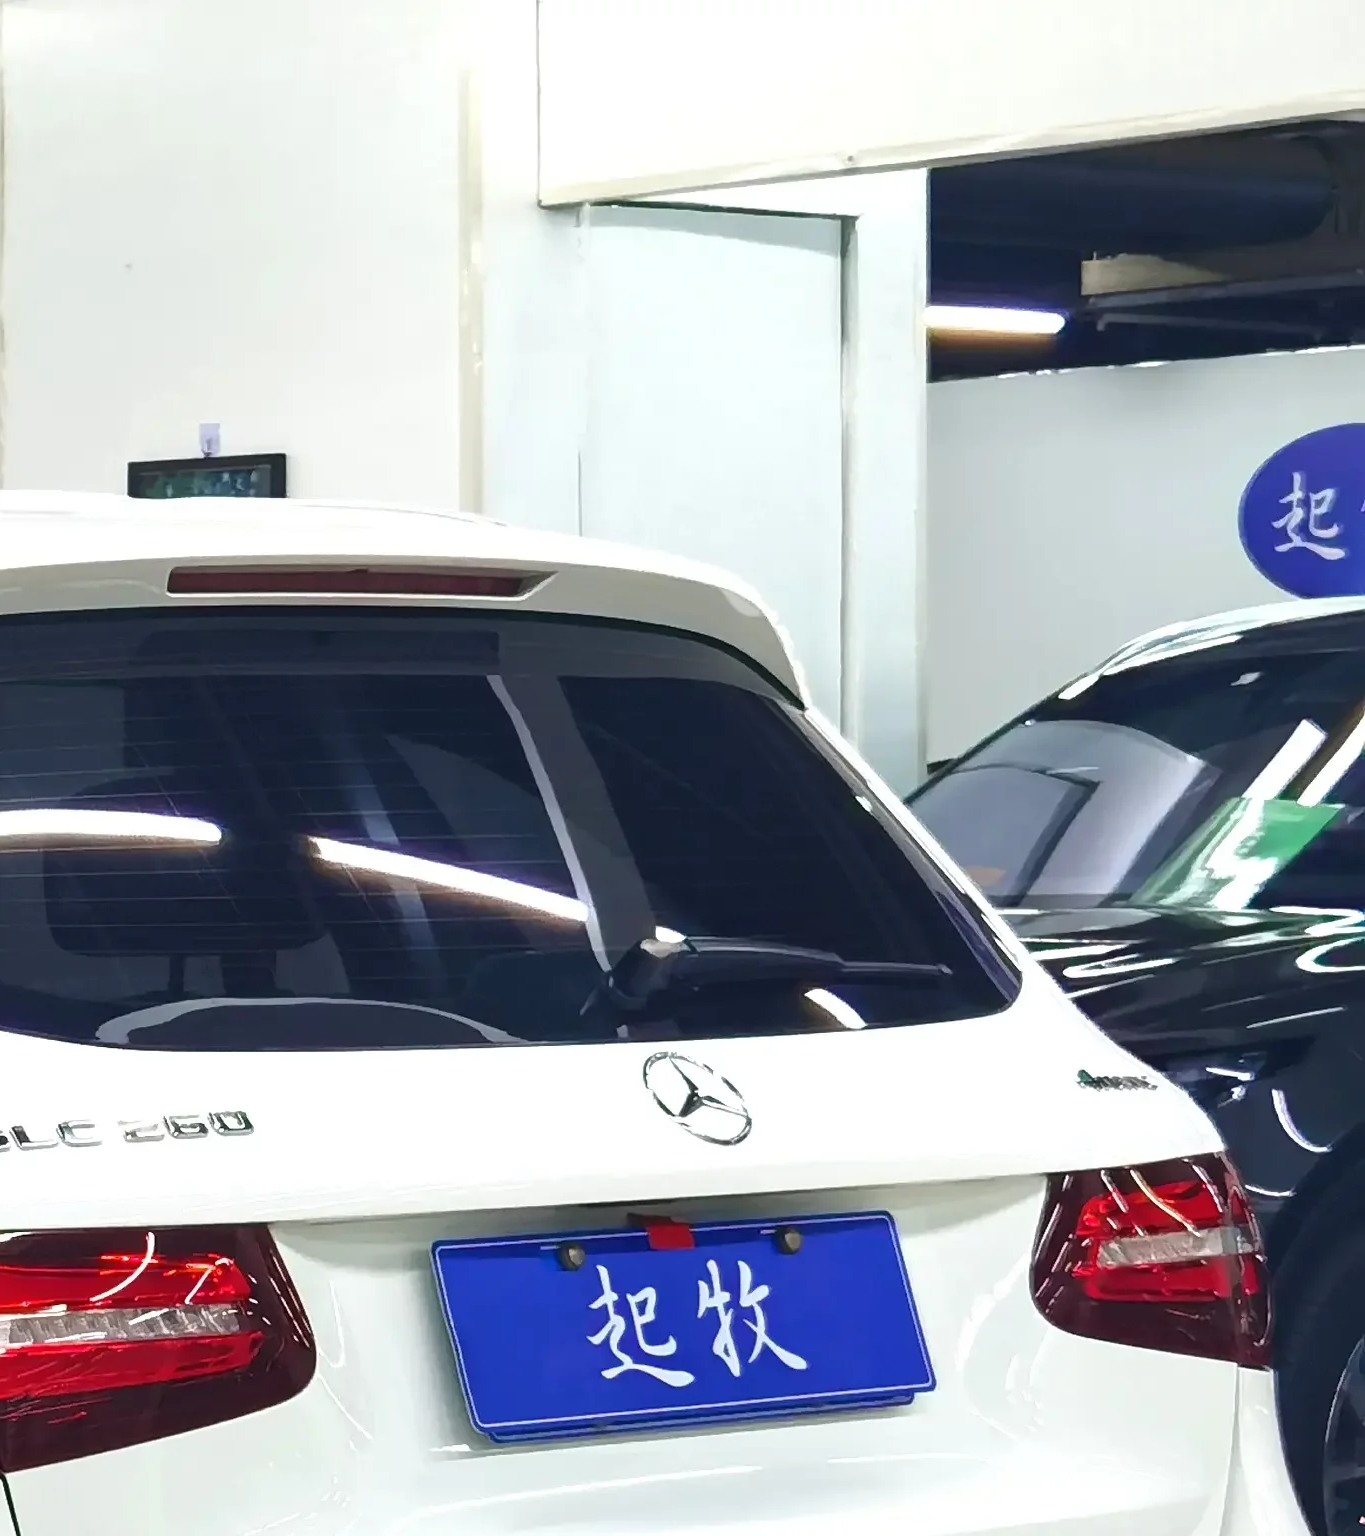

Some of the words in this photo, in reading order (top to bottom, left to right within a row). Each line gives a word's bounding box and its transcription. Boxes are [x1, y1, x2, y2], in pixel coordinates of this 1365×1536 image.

[1271, 471, 1365, 561] 起
[117, 1110, 255, 1143] 260
[586, 1259, 809, 1388] 起牧
